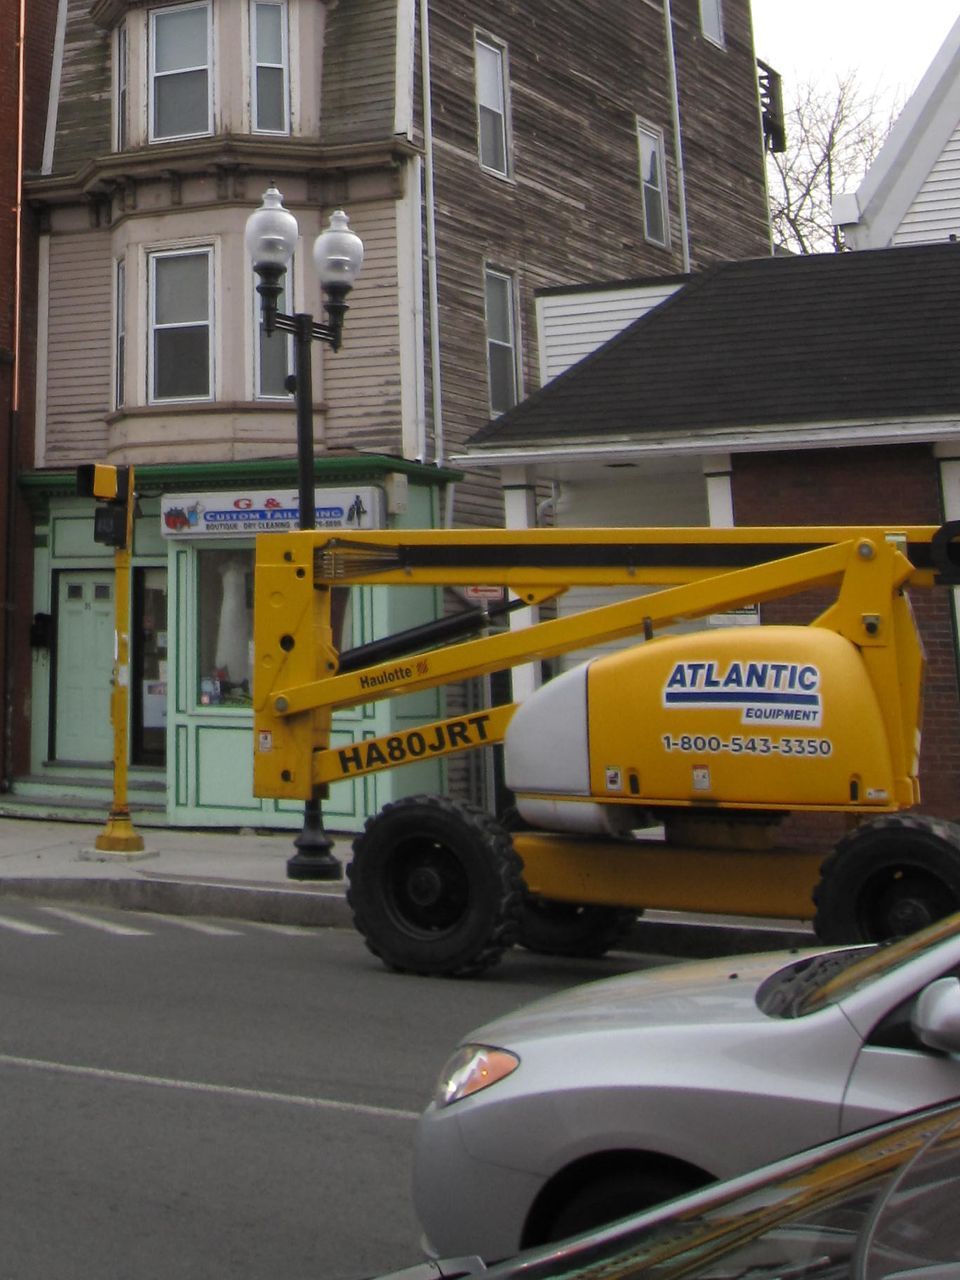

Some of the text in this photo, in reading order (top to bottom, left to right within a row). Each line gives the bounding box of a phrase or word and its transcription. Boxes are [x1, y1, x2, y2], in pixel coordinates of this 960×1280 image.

[233, 498, 282, 509] G &
[205, 508, 341, 521] CUSTOM TAILING
[206, 522, 238, 531] BOUTIQUE
[360, 665, 413, 689] Haulotte
[667, 663, 818, 691] ATLANTIC
[745, 707, 819, 721] EQUIPMENT
[339, 715, 489, 773] HA80JRT
[663, 735, 832, 756] 1-800-543-3350
